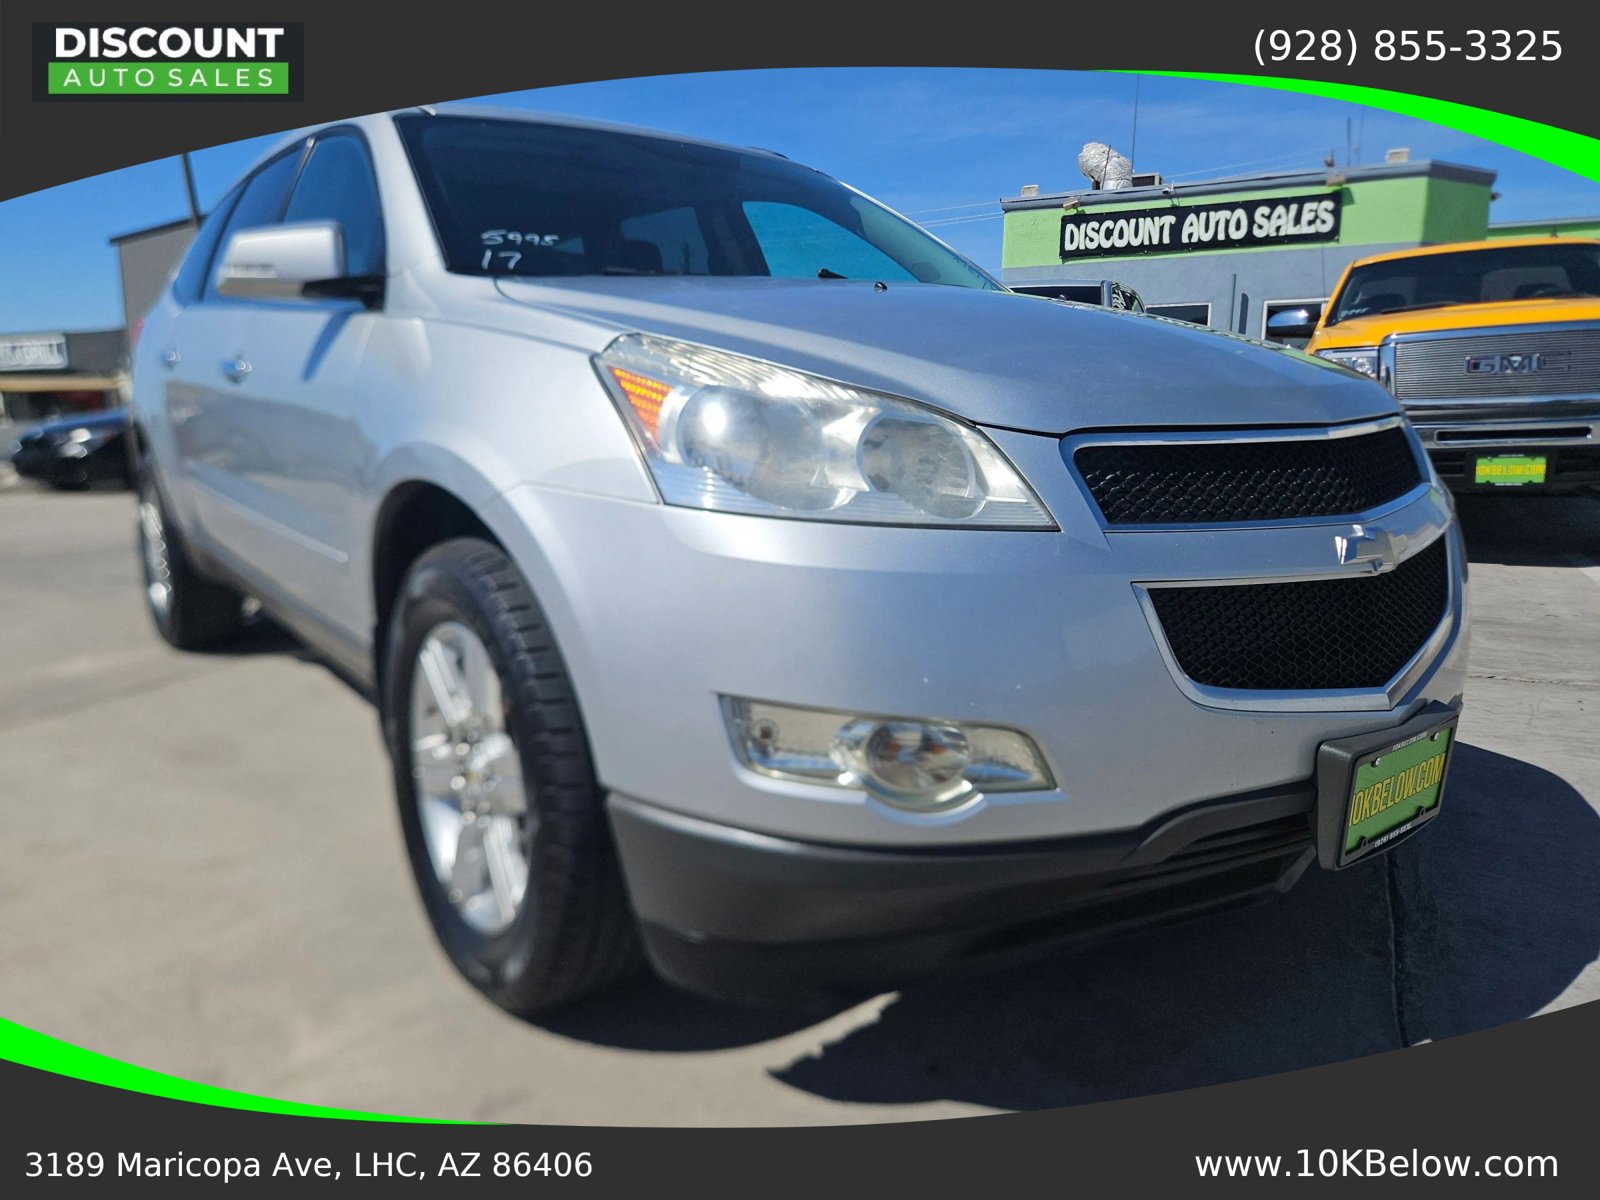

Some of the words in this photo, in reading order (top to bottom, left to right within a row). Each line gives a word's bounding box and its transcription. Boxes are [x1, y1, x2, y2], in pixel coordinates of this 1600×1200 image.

[481, 229, 560, 247] 5995
[1064, 214, 1176, 251] DISCOUNT
[1181, 208, 1249, 244] AUTO
[1252, 200, 1336, 239] SALES
[481, 249, 522, 270] 17
[1348, 752, 1446, 827] 10KBELOW.COM
